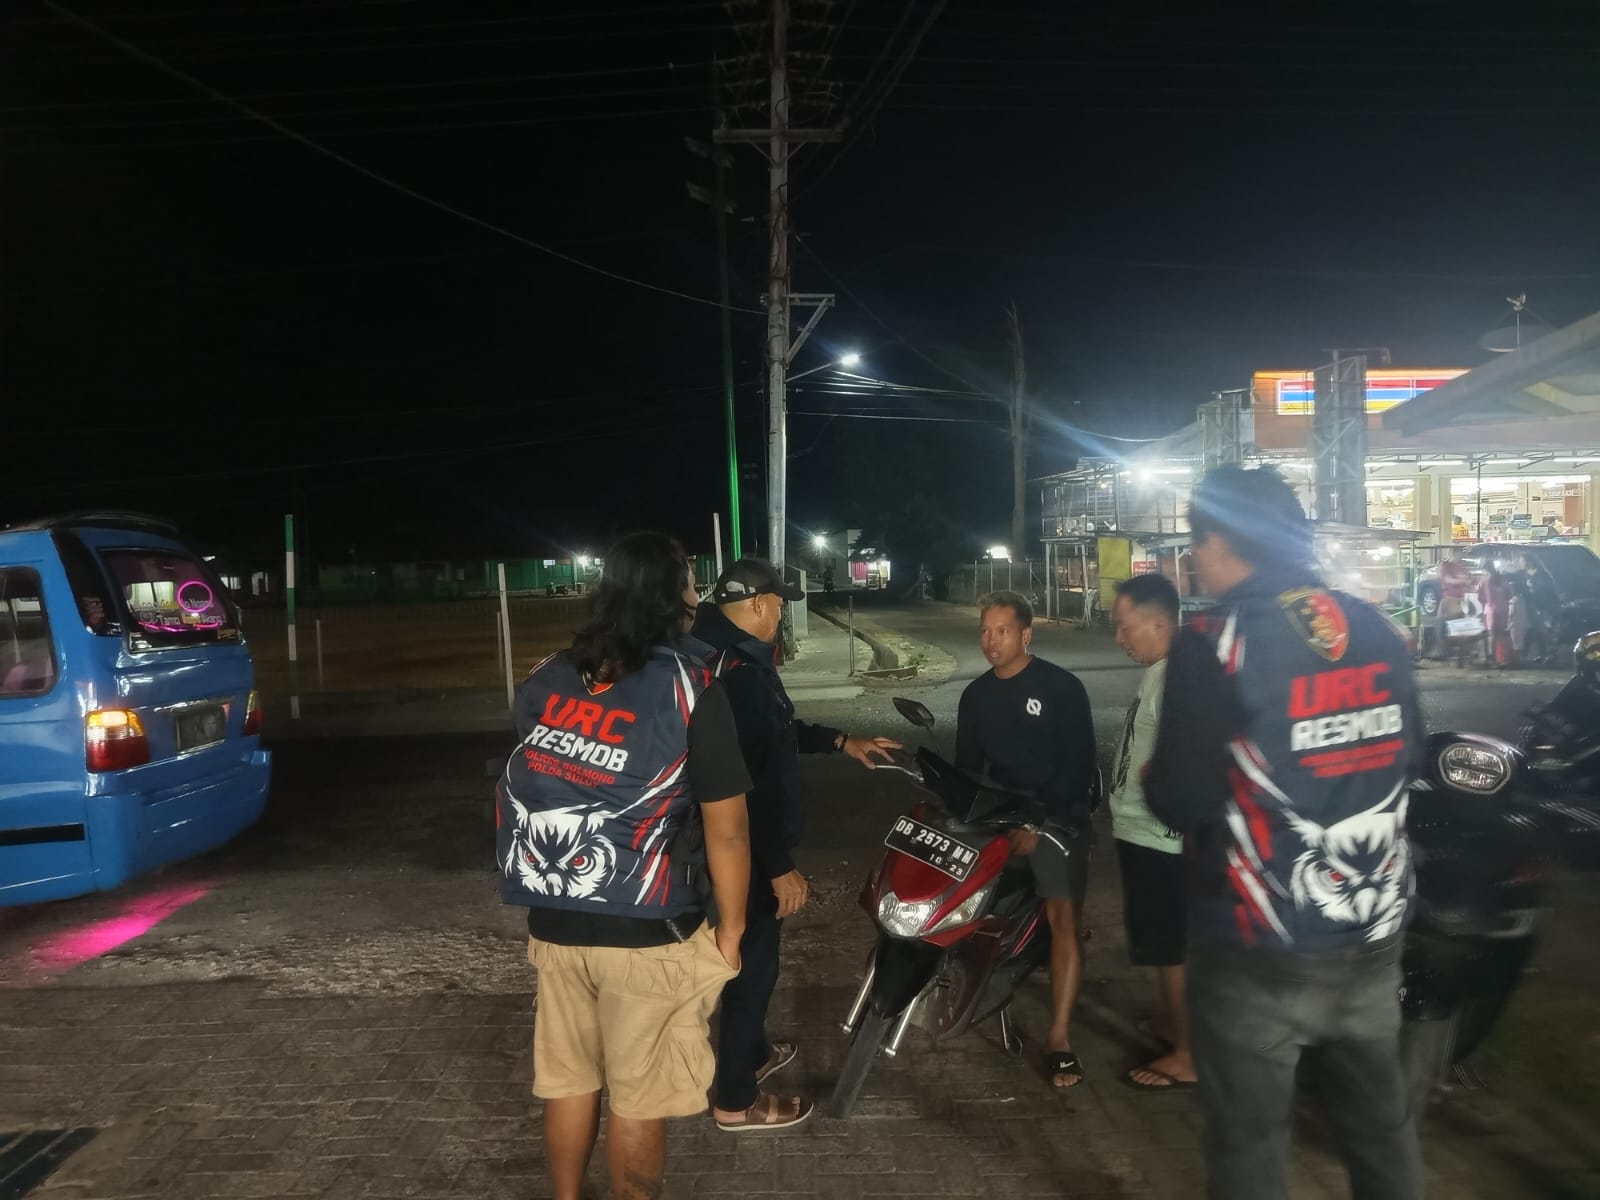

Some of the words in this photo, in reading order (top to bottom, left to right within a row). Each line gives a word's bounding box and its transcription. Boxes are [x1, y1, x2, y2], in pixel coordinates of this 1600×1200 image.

[1288, 662, 1391, 719] URC
[540, 693, 636, 743] URC
[1291, 704, 1403, 751] RESMOB
[524, 725, 629, 772] RESMOB
[895, 820, 914, 835] DB
[916, 829, 950, 851] 2573
